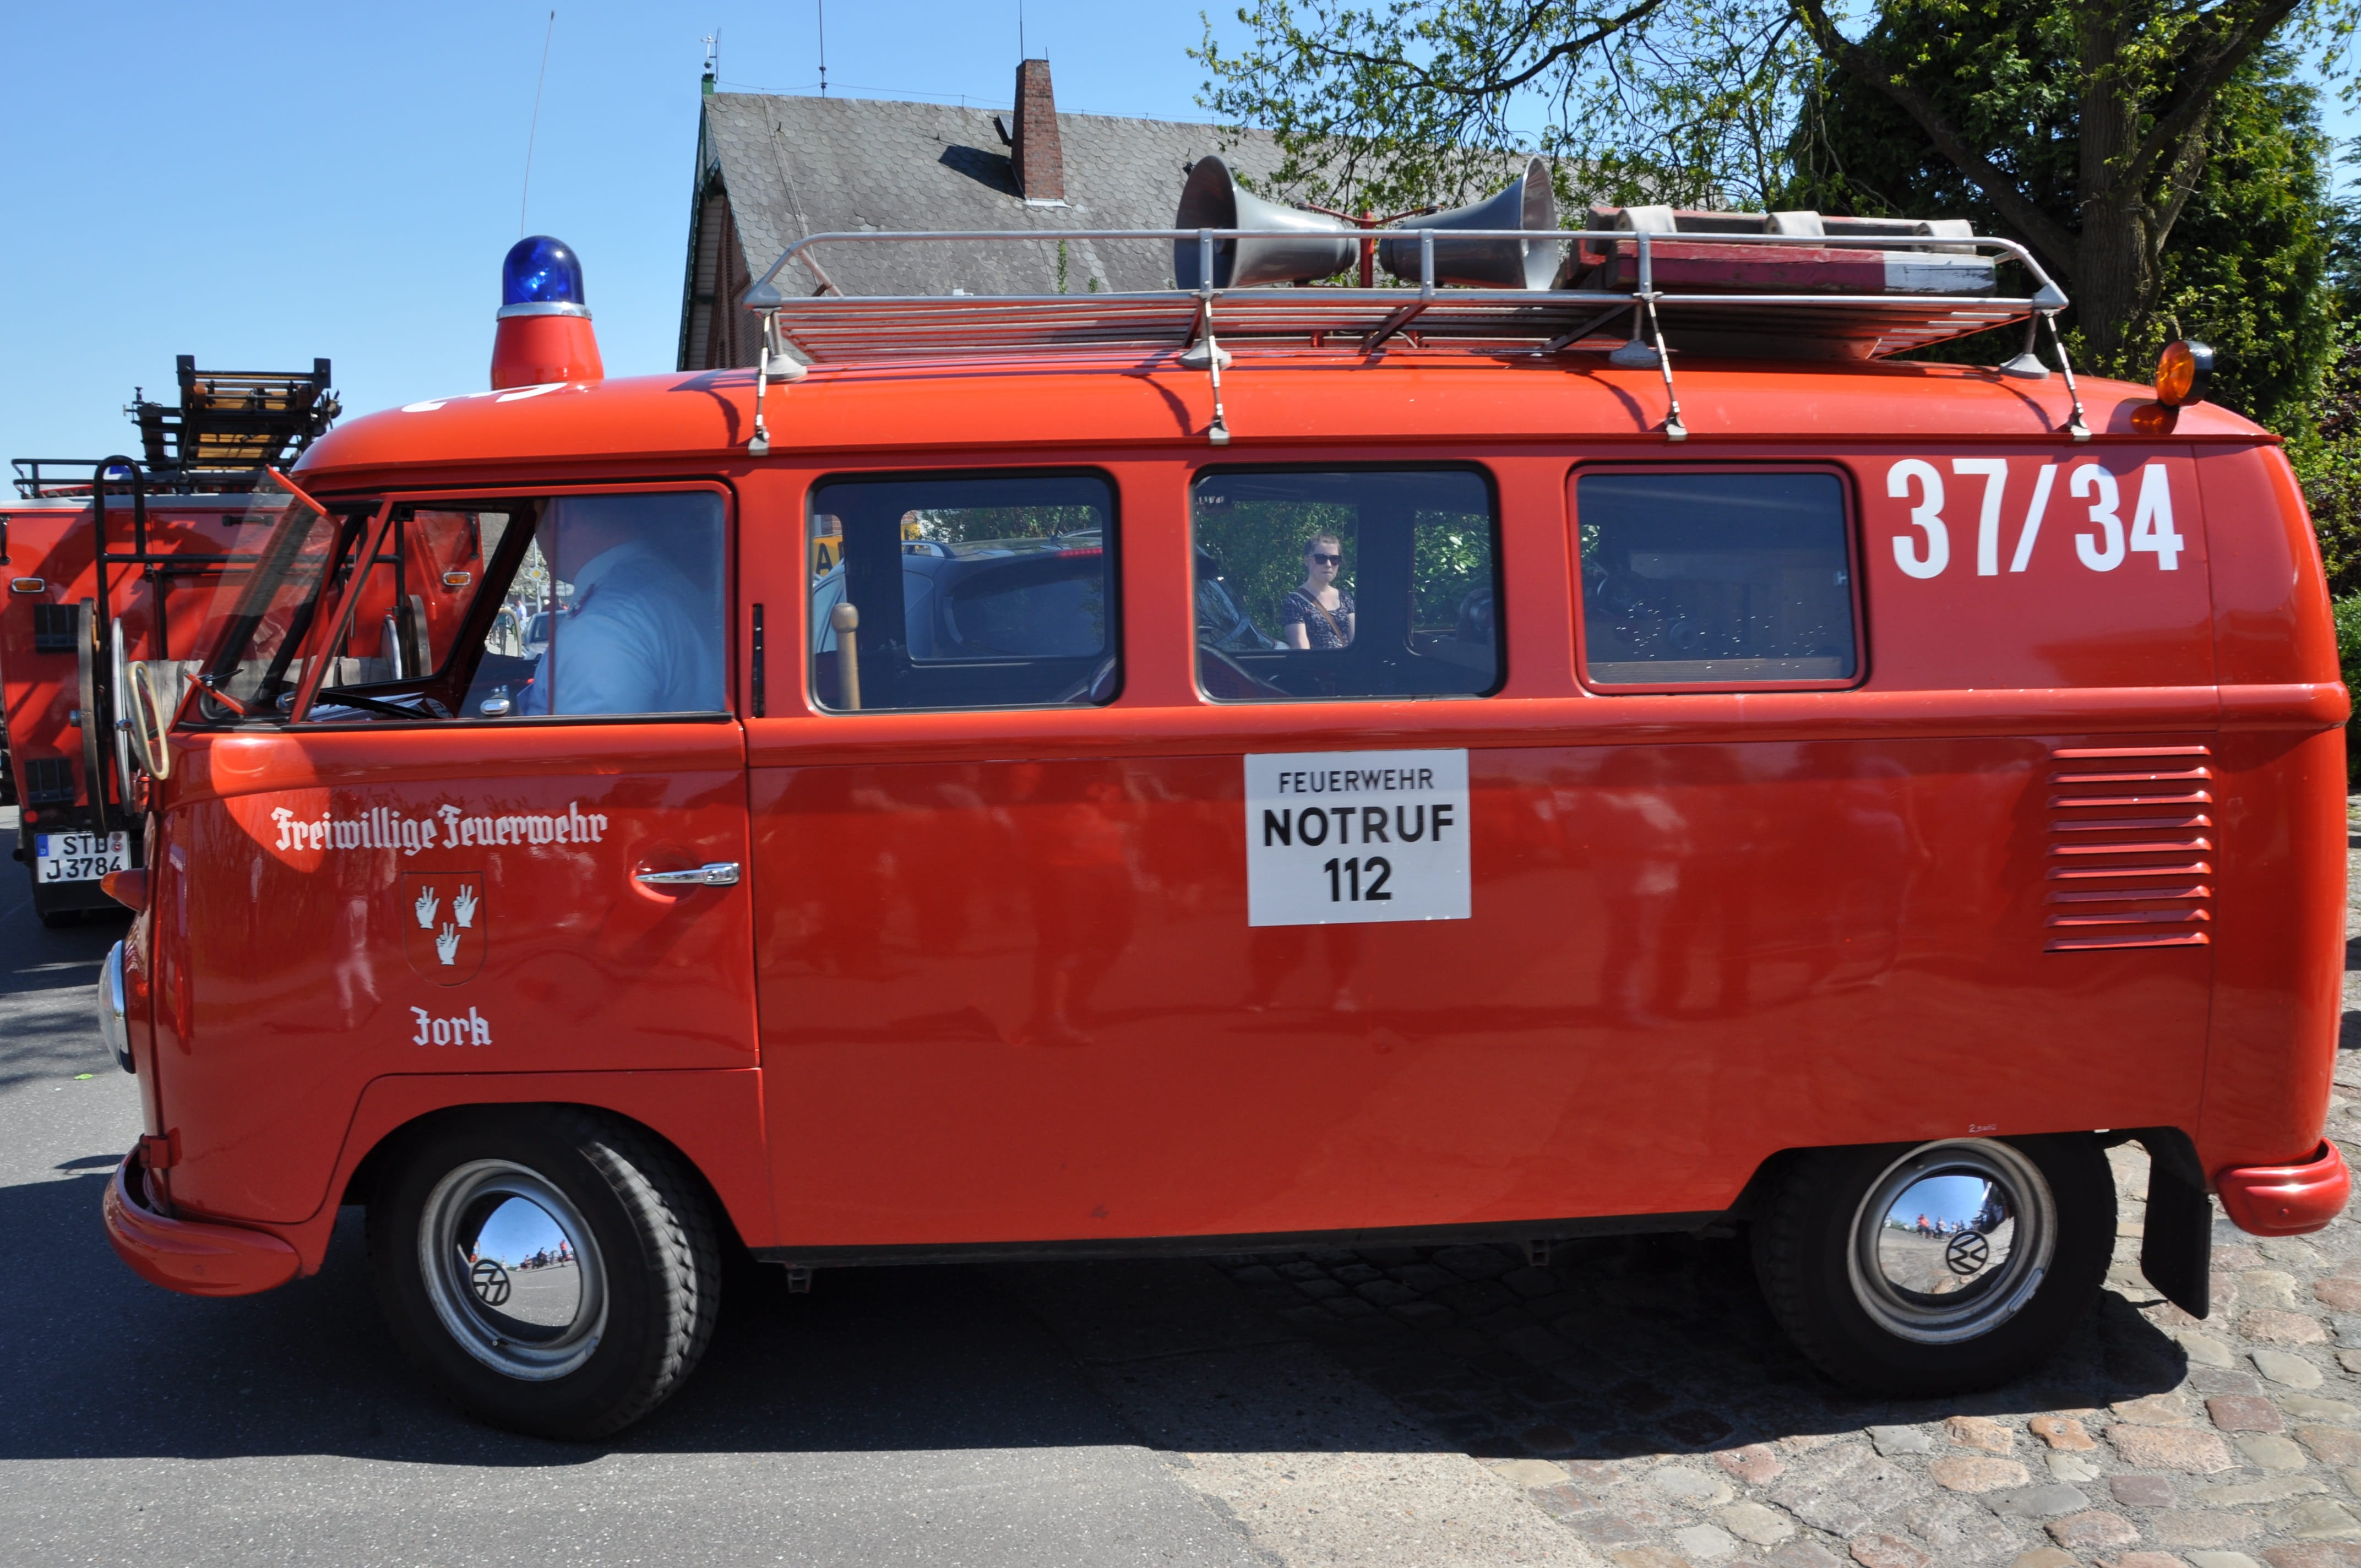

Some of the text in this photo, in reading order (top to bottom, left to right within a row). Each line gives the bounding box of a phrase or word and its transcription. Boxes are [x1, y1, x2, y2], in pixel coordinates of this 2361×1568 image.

[1887, 458, 2184, 579] 37/34
[1279, 768, 1435, 793] FEUERWEHR
[271, 801, 608, 856] Freiwillige Feuerwehr
[1264, 804, 1454, 846] NOTRUF
[66, 856, 123, 879] 3784
[1324, 856, 1392, 902] 112
[410, 1006, 493, 1046] Jork
